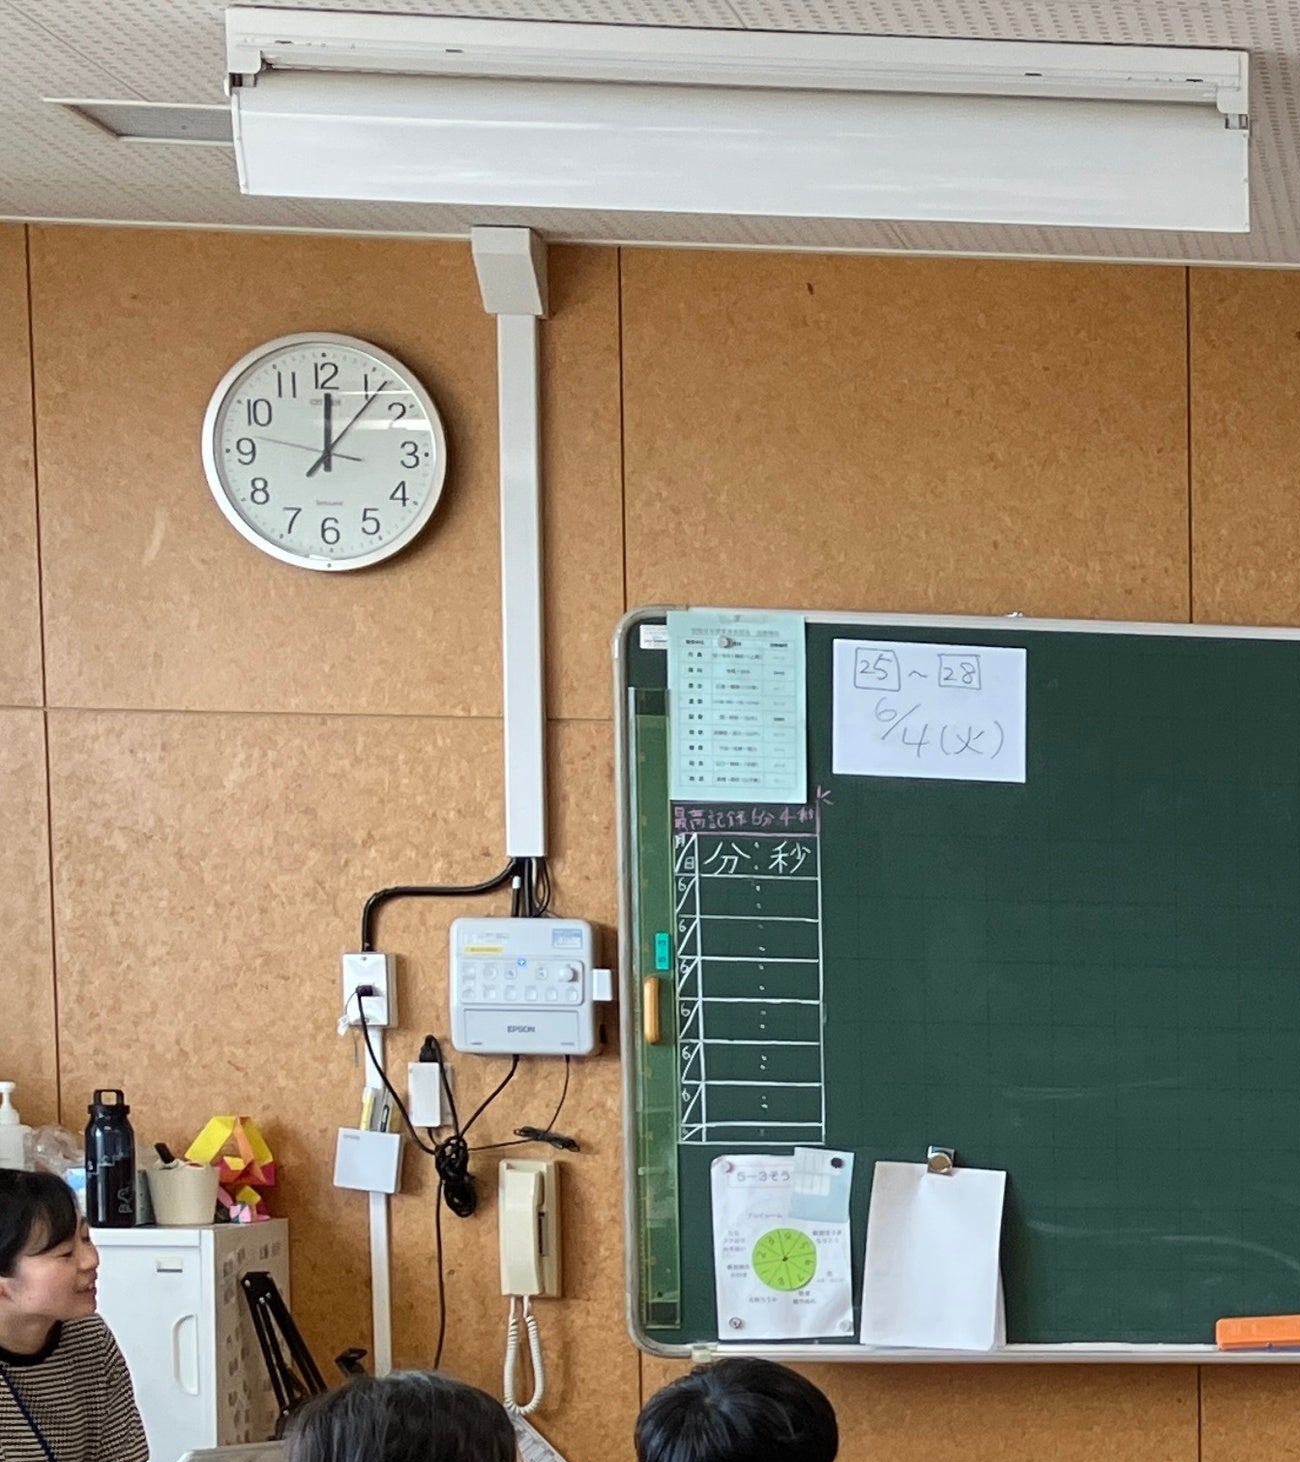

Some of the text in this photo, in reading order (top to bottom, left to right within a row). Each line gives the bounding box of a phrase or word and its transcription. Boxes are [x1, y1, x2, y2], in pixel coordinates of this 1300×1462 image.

[276, 370, 297, 399] 11
[313, 362, 340, 390] 12
[363, 373, 370, 401] 1
[247, 398, 273, 427] 10
[235, 437, 257, 466] 9
[400, 440, 420, 469] 3
[250, 477, 270, 506] 8
[389, 480, 410, 508] 4
[283, 506, 302, 534] 7
[320, 517, 340, 545] 6
[361, 508, 381, 536] 5
[506, 1025, 536, 1033] EPSON
